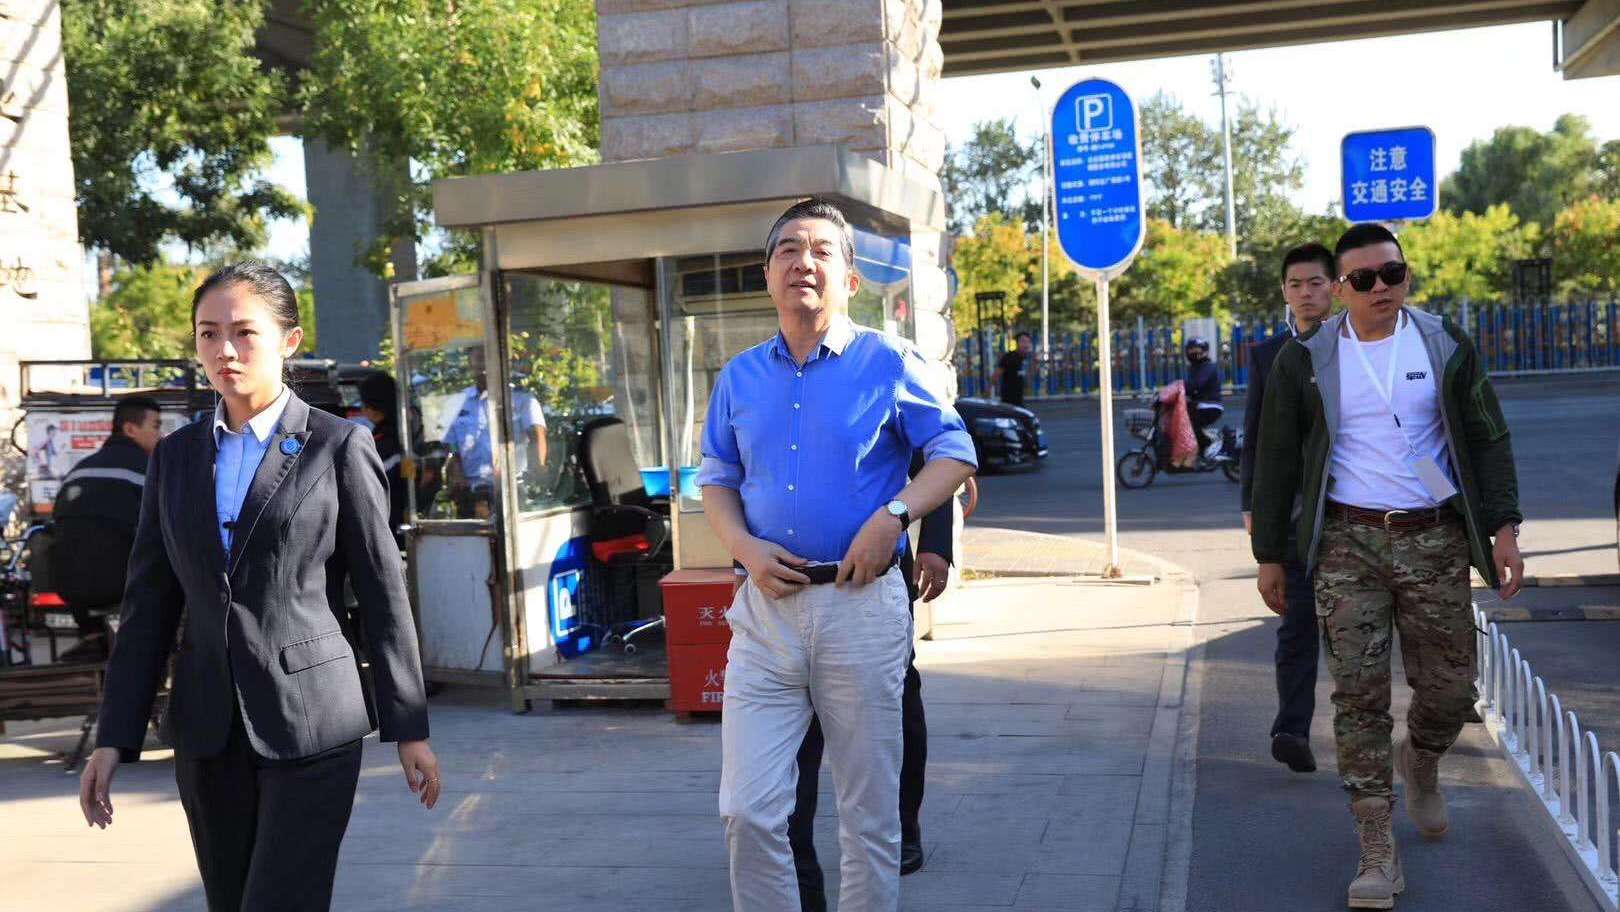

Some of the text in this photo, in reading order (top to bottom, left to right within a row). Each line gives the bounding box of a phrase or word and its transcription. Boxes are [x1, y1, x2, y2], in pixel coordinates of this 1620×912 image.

[1084, 97, 1104, 130] P
[1369, 145, 1407, 172] 注意
[1351, 177, 1428, 205] 交通安全
[704, 669, 726, 688] 火
